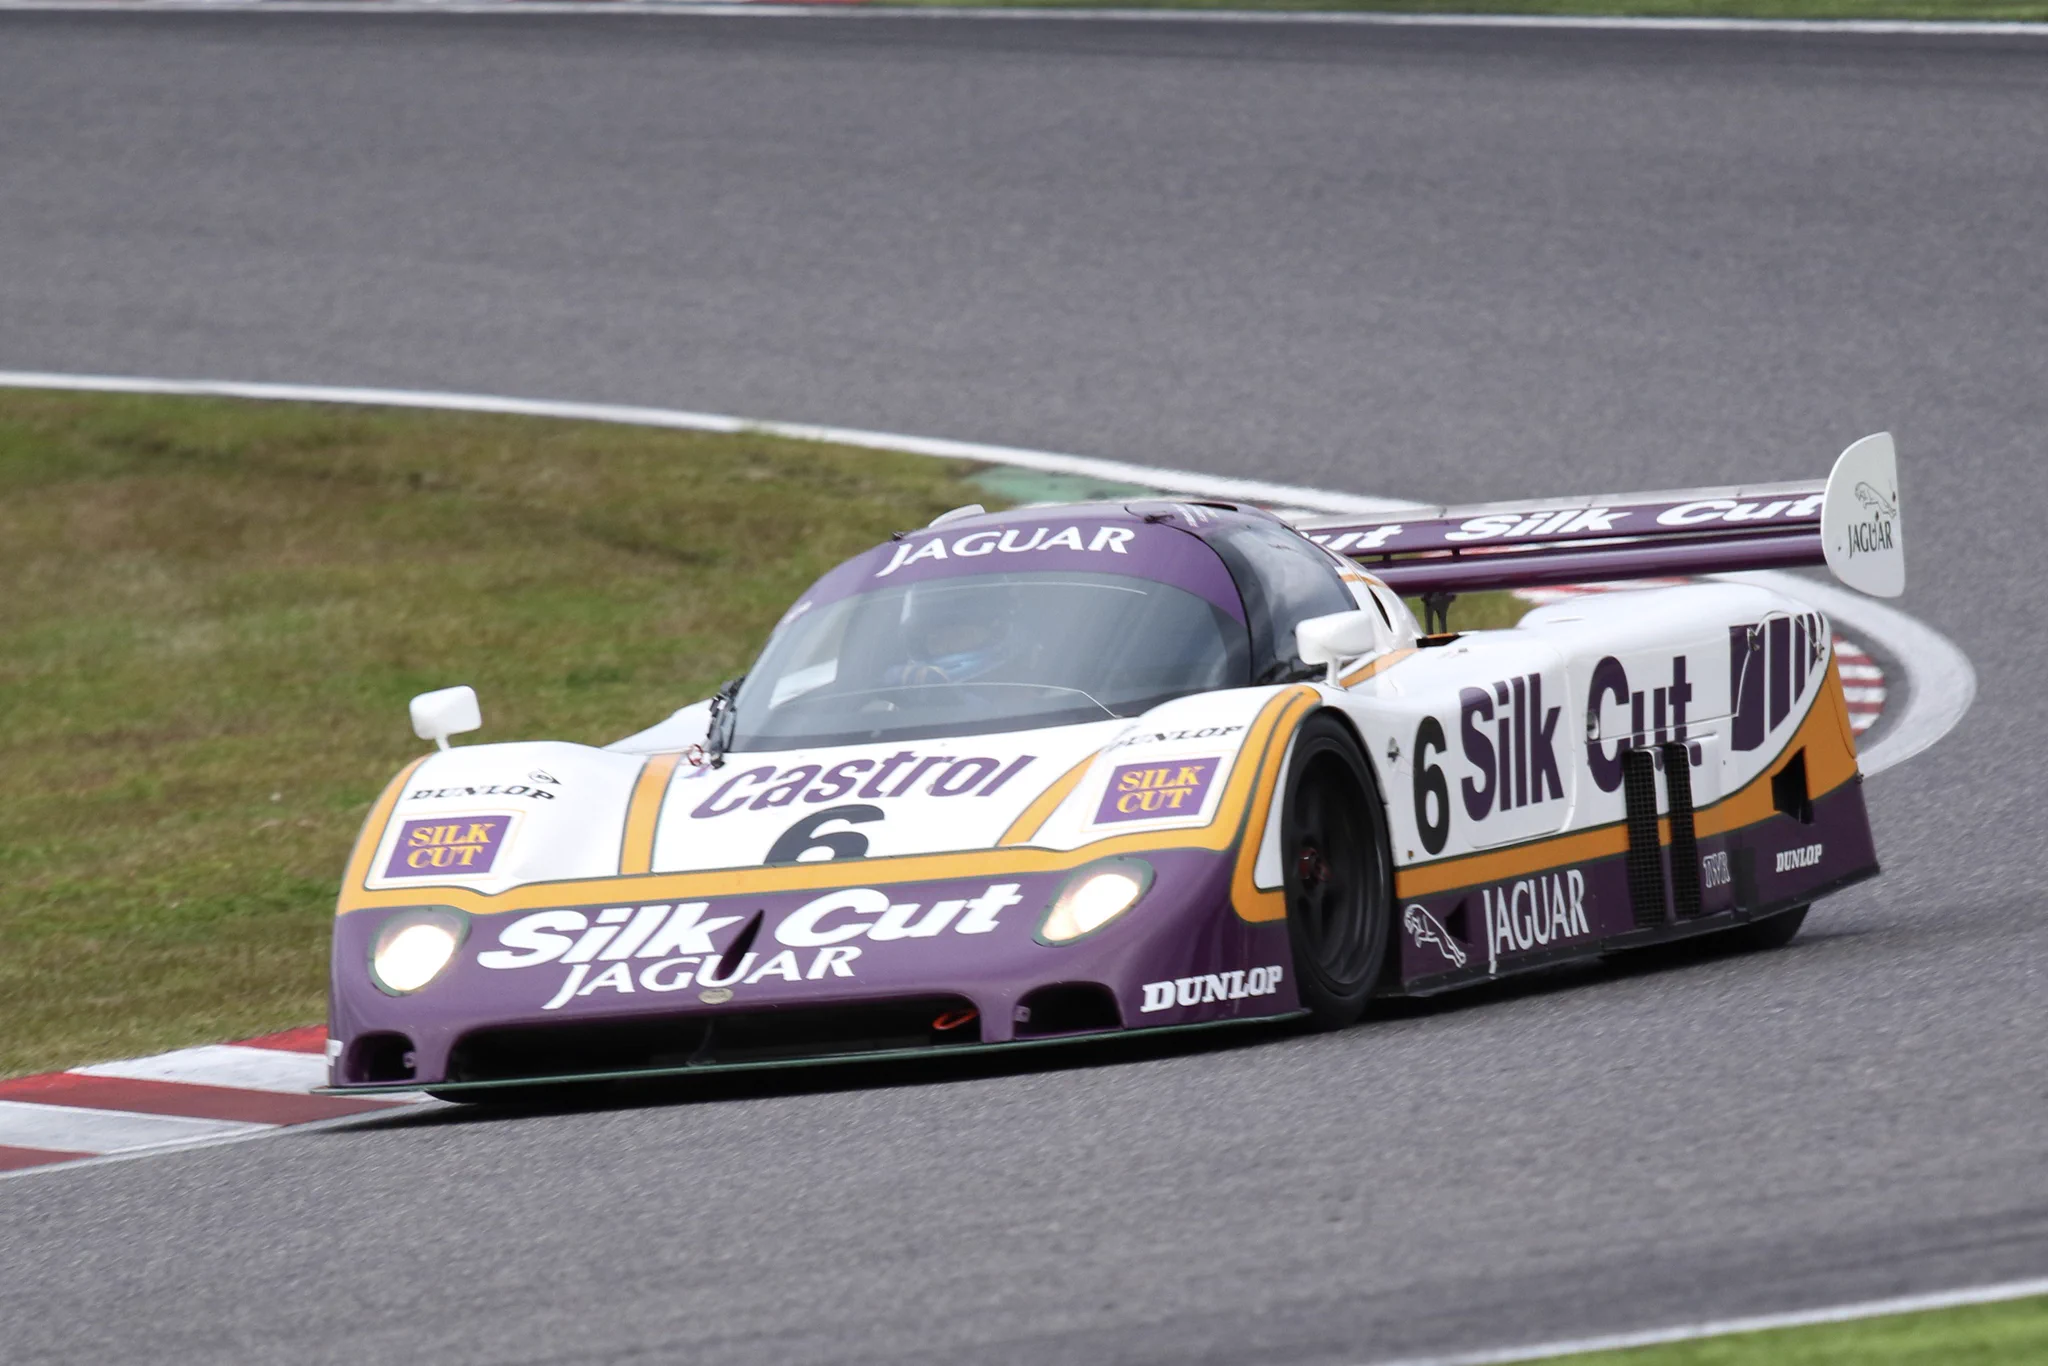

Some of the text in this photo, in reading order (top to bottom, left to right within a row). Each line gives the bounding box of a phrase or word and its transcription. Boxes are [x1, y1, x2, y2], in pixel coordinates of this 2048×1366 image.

[1300, 493, 1825, 550] ut Silk Cut
[1848, 521, 1894, 560] JAGUAR
[875, 526, 1135, 578] JAGUAR
[1459, 655, 1703, 822] Silk Cut
[407, 785, 556, 801] DUNLOP
[690, 750, 1038, 819] Castrol
[1116, 765, 1206, 792] SILK
[1116, 787, 1193, 814] CUT
[1413, 715, 1450, 855] 6
[406, 845, 484, 869] CUT
[408, 823, 497, 847] SILK
[1776, 843, 1823, 873] DUNLOP
[478, 883, 1023, 970] Silk Cut
[1482, 868, 1590, 974] JAGUAR
[541, 945, 862, 1010] JAGUAR
[1139, 965, 1283, 1014] DUNLOP
